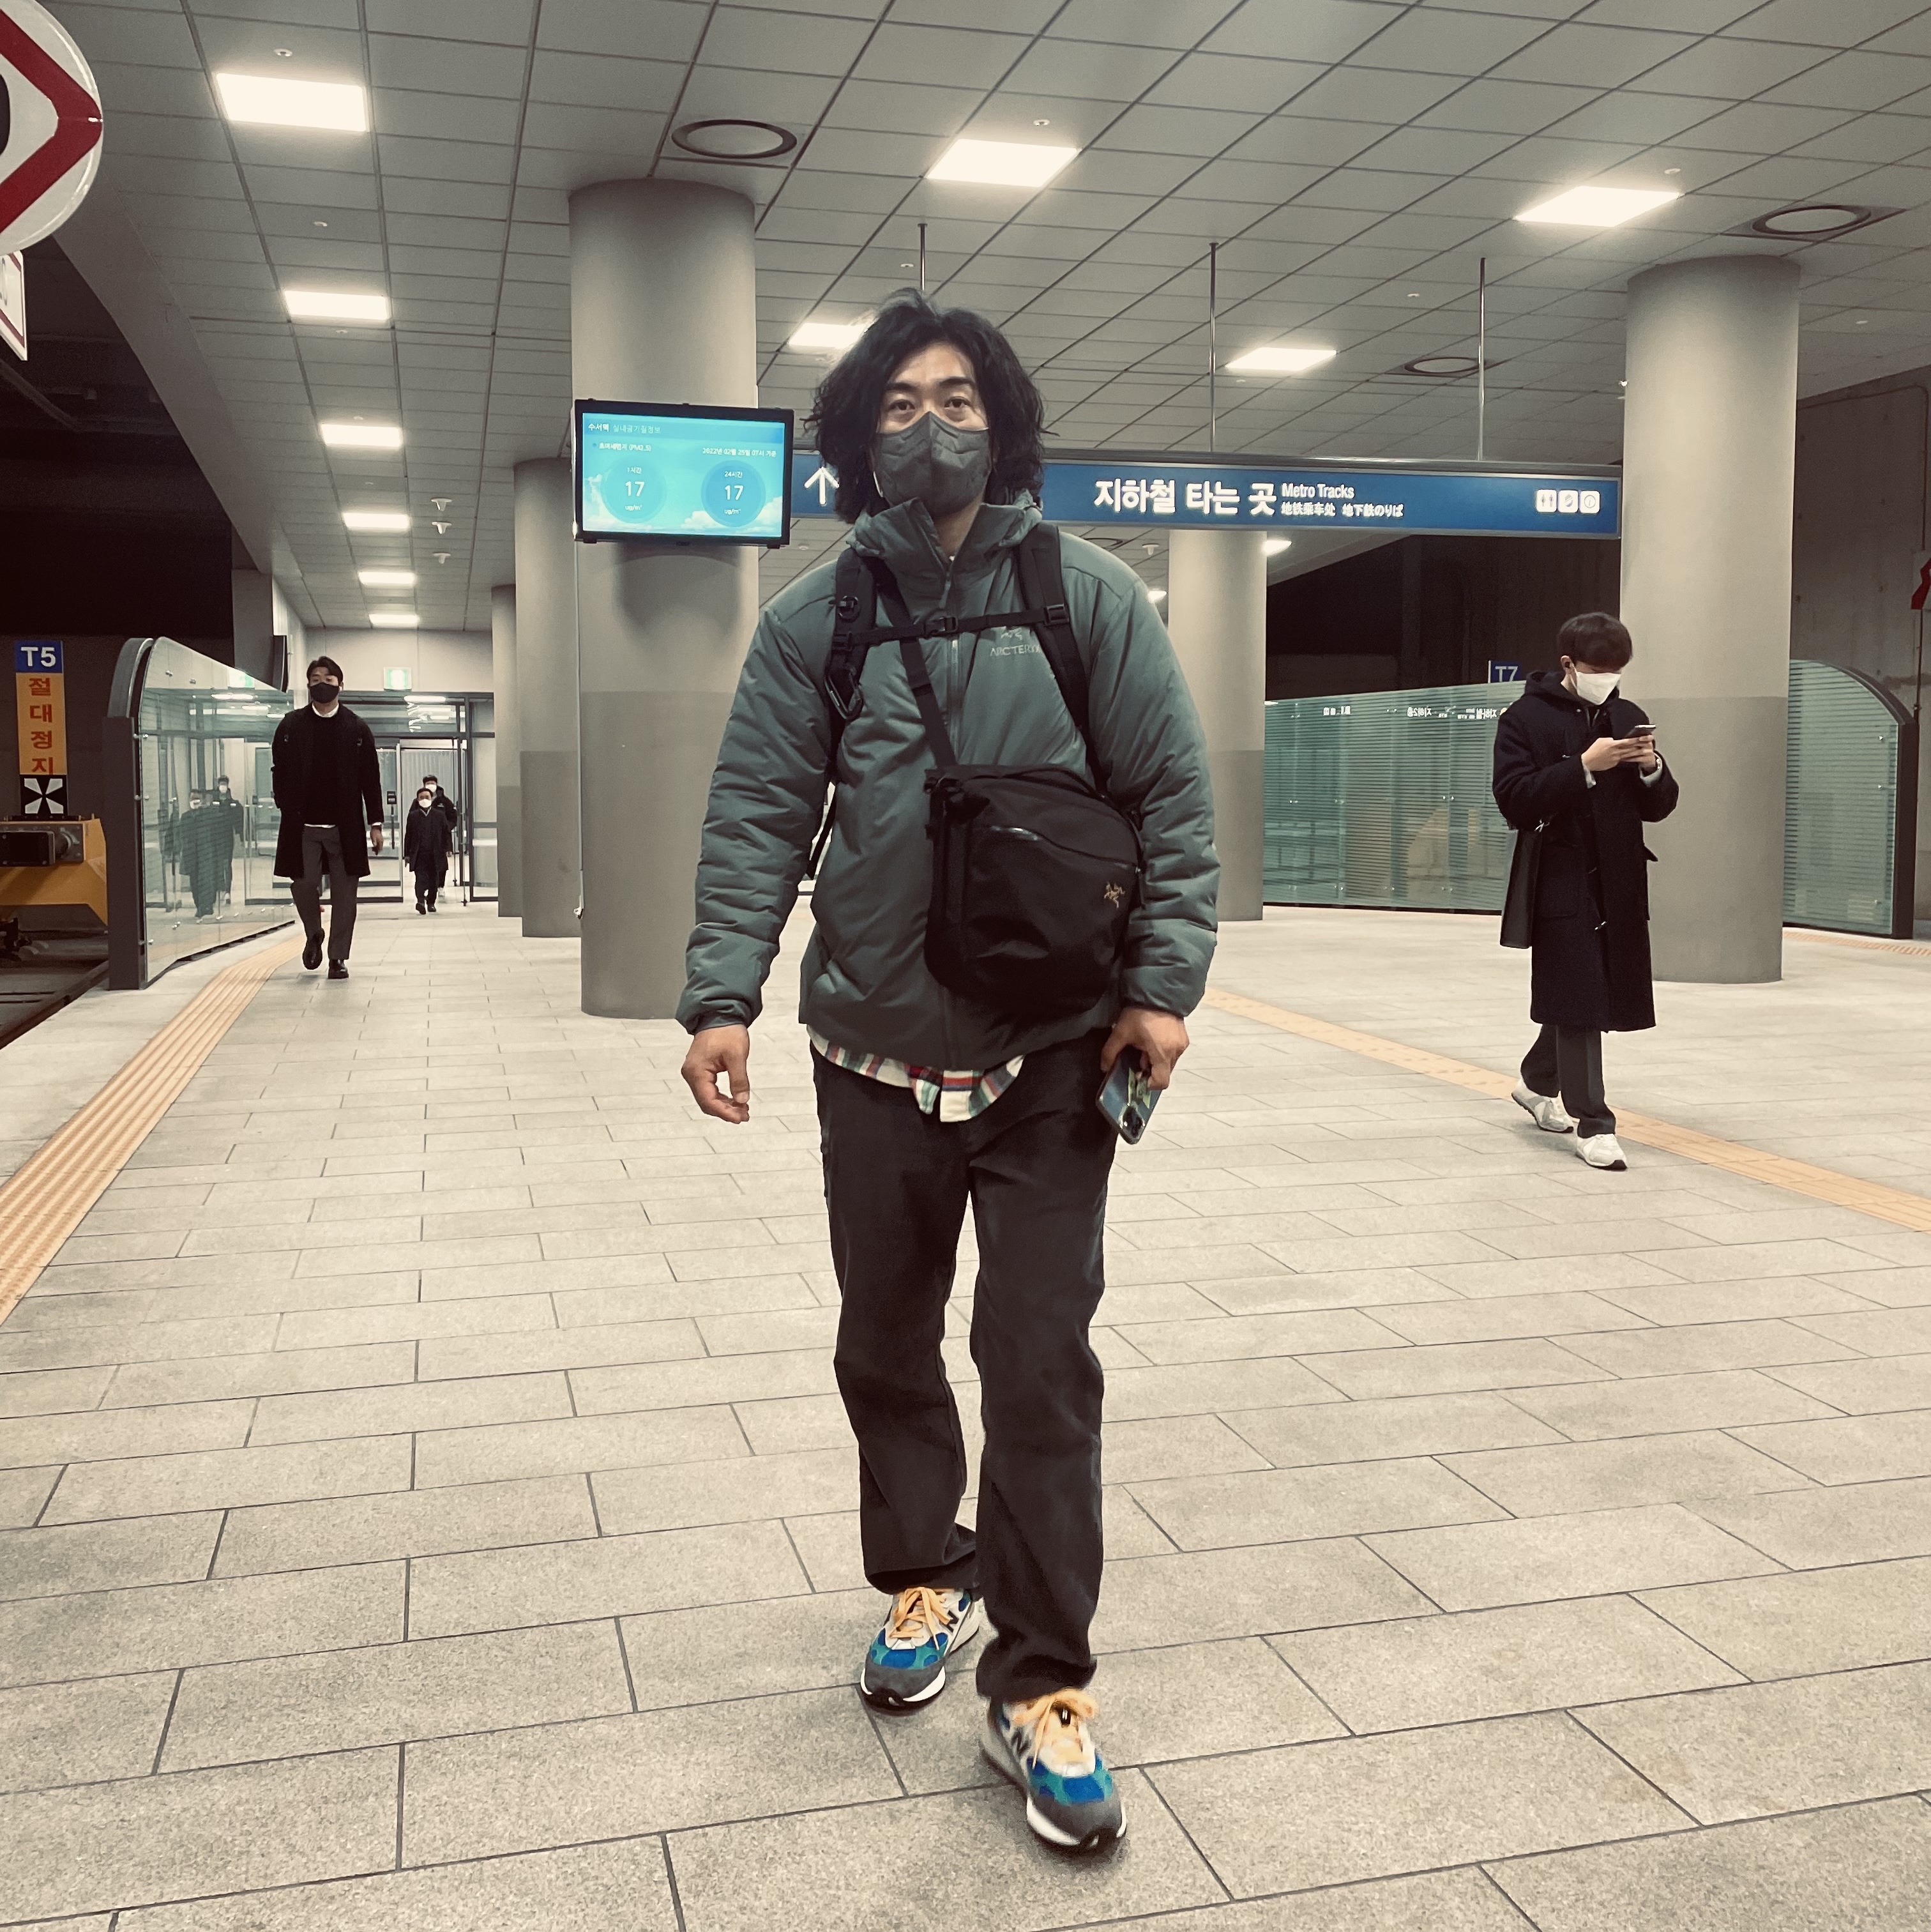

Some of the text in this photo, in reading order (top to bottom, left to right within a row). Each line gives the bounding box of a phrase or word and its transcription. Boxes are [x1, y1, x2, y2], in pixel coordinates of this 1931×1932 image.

[588, 423, 609, 432] 수서역
[625, 481, 645, 497] 17
[725, 485, 744, 501] 17
[1094, 478, 1277, 516] 지하철 타는 곳
[1282, 483, 1354, 499] Metro Tracks
[1281, 501, 1336, 516] 地铁乘车处
[1342, 503, 1404, 517] 地下鉄のりば
[20, 646, 56, 667] T5
[1495, 666, 1518, 682] T7
